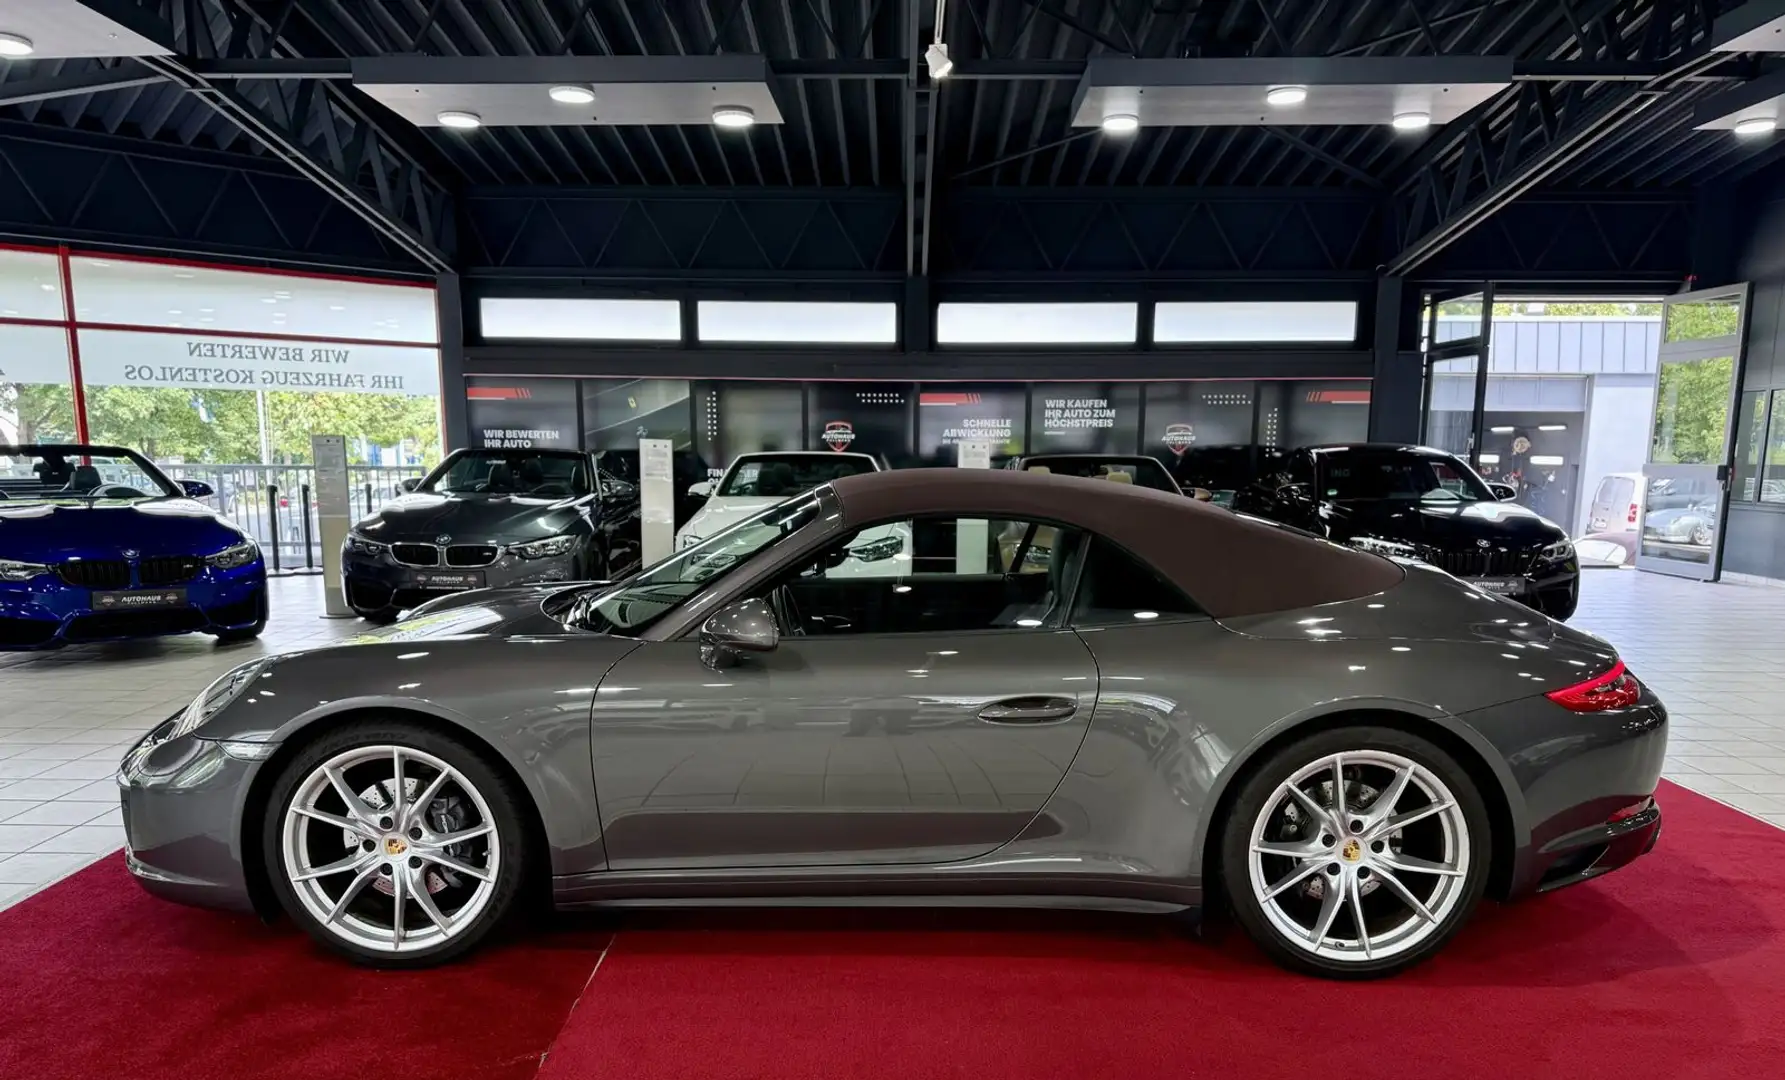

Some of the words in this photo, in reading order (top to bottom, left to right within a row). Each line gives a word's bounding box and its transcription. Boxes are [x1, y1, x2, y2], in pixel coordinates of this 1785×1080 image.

[1045, 399, 1066, 408] WIR
[1066, 399, 1108, 408] KAUFEN
[1044, 409, 1062, 418] IHR
[1063, 409, 1092, 418] AUTO
[1093, 409, 1116, 418] ZUM
[963, 419, 1012, 428] SCHNELLE
[483, 429, 504, 439] WIR
[505, 429, 560, 439] BEWERTEN
[942, 428, 1012, 438] ABWICKLUNG
[484, 439, 502, 448] IHR
[503, 439, 532, 448] AUTO
